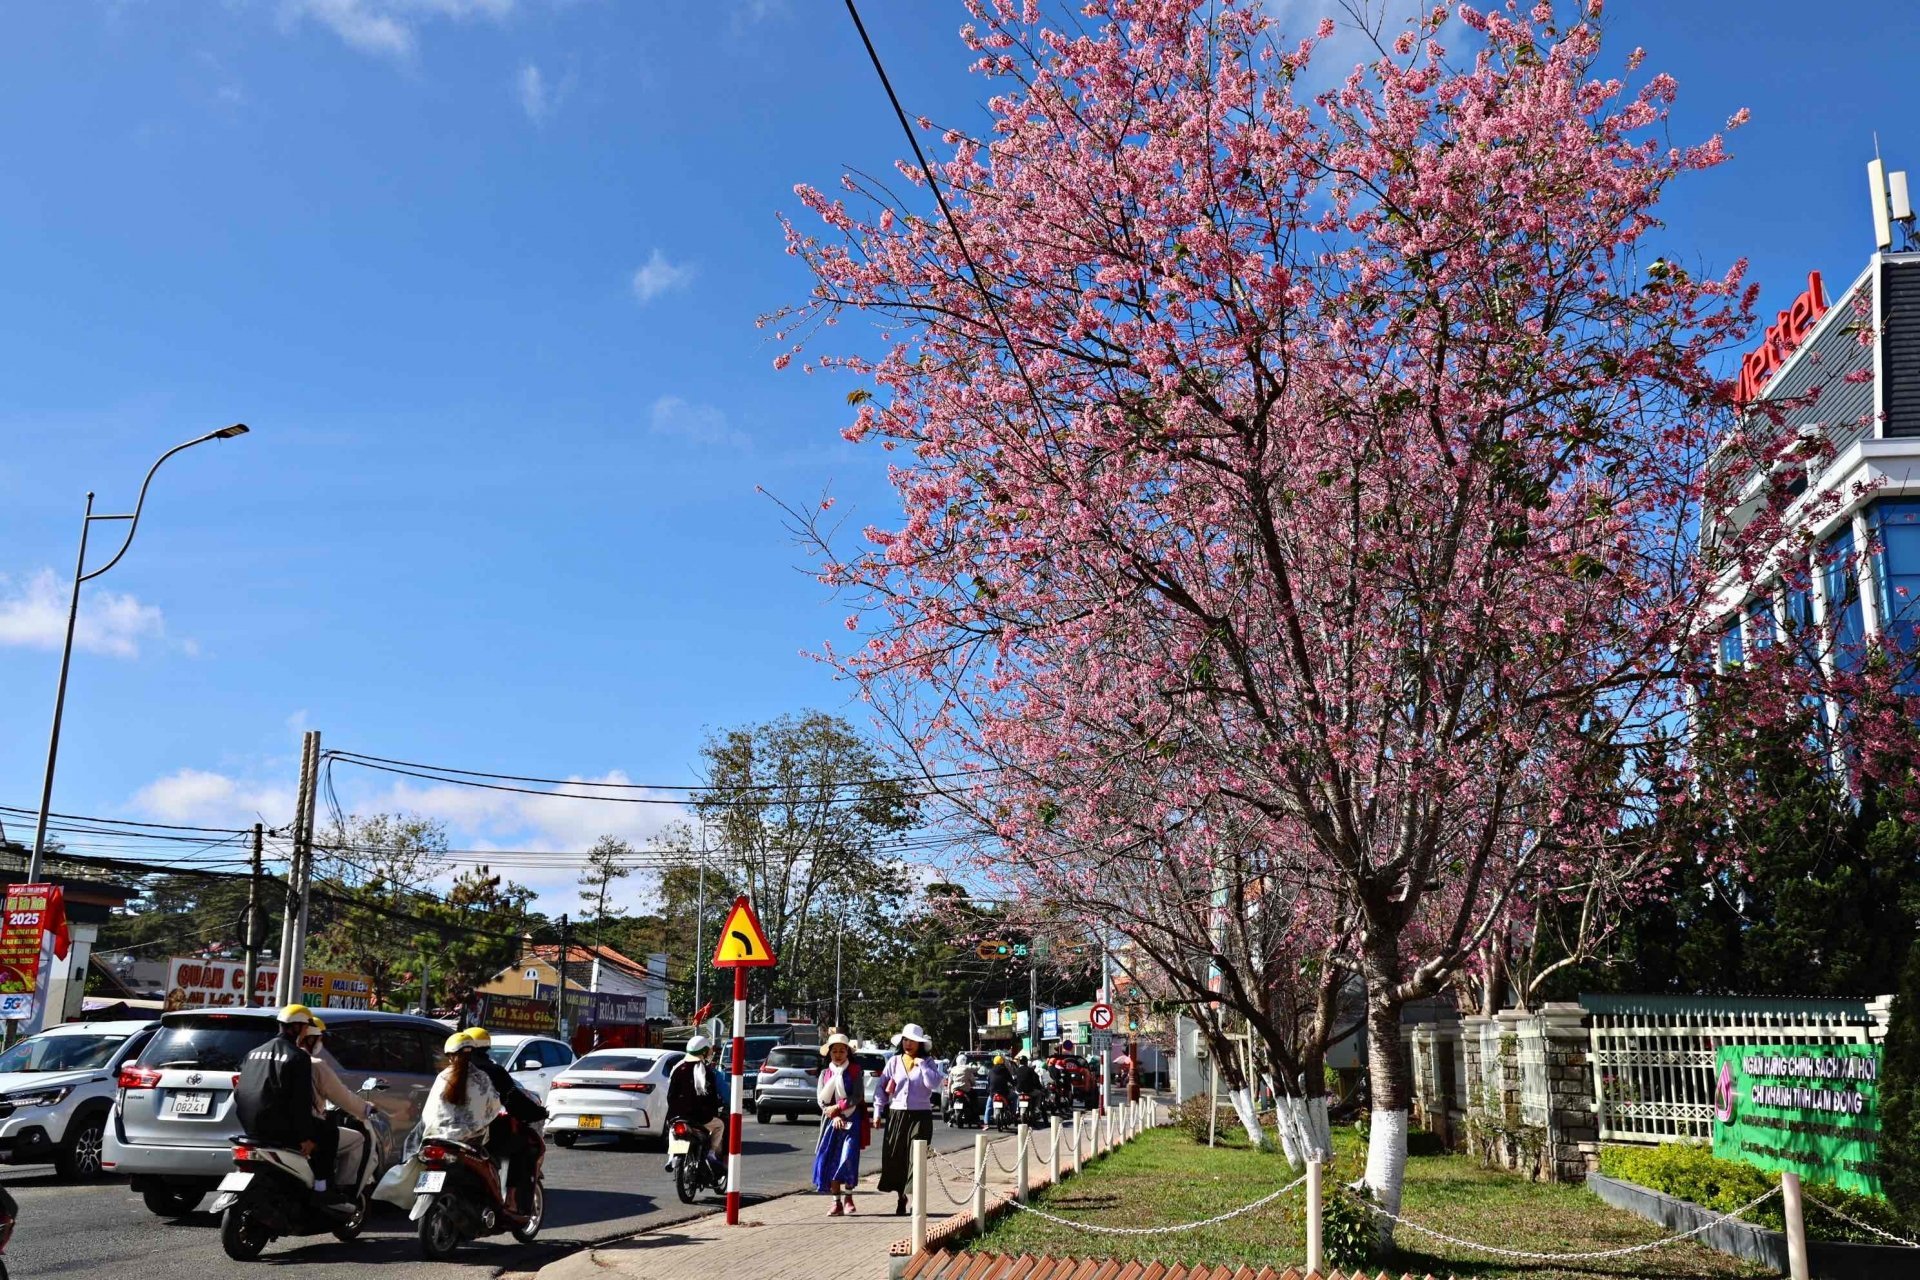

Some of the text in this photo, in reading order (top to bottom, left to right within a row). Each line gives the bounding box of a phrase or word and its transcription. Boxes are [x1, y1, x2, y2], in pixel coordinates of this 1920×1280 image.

[9, 912, 40, 925] 2025
[1013, 944, 1027, 956] 56
[232, 968, 279, 992] CAY
[3, 997, 22, 1010] 5G
[185, 1092, 201, 1103] 51L
[175, 1102, 204, 1112] 082.41
